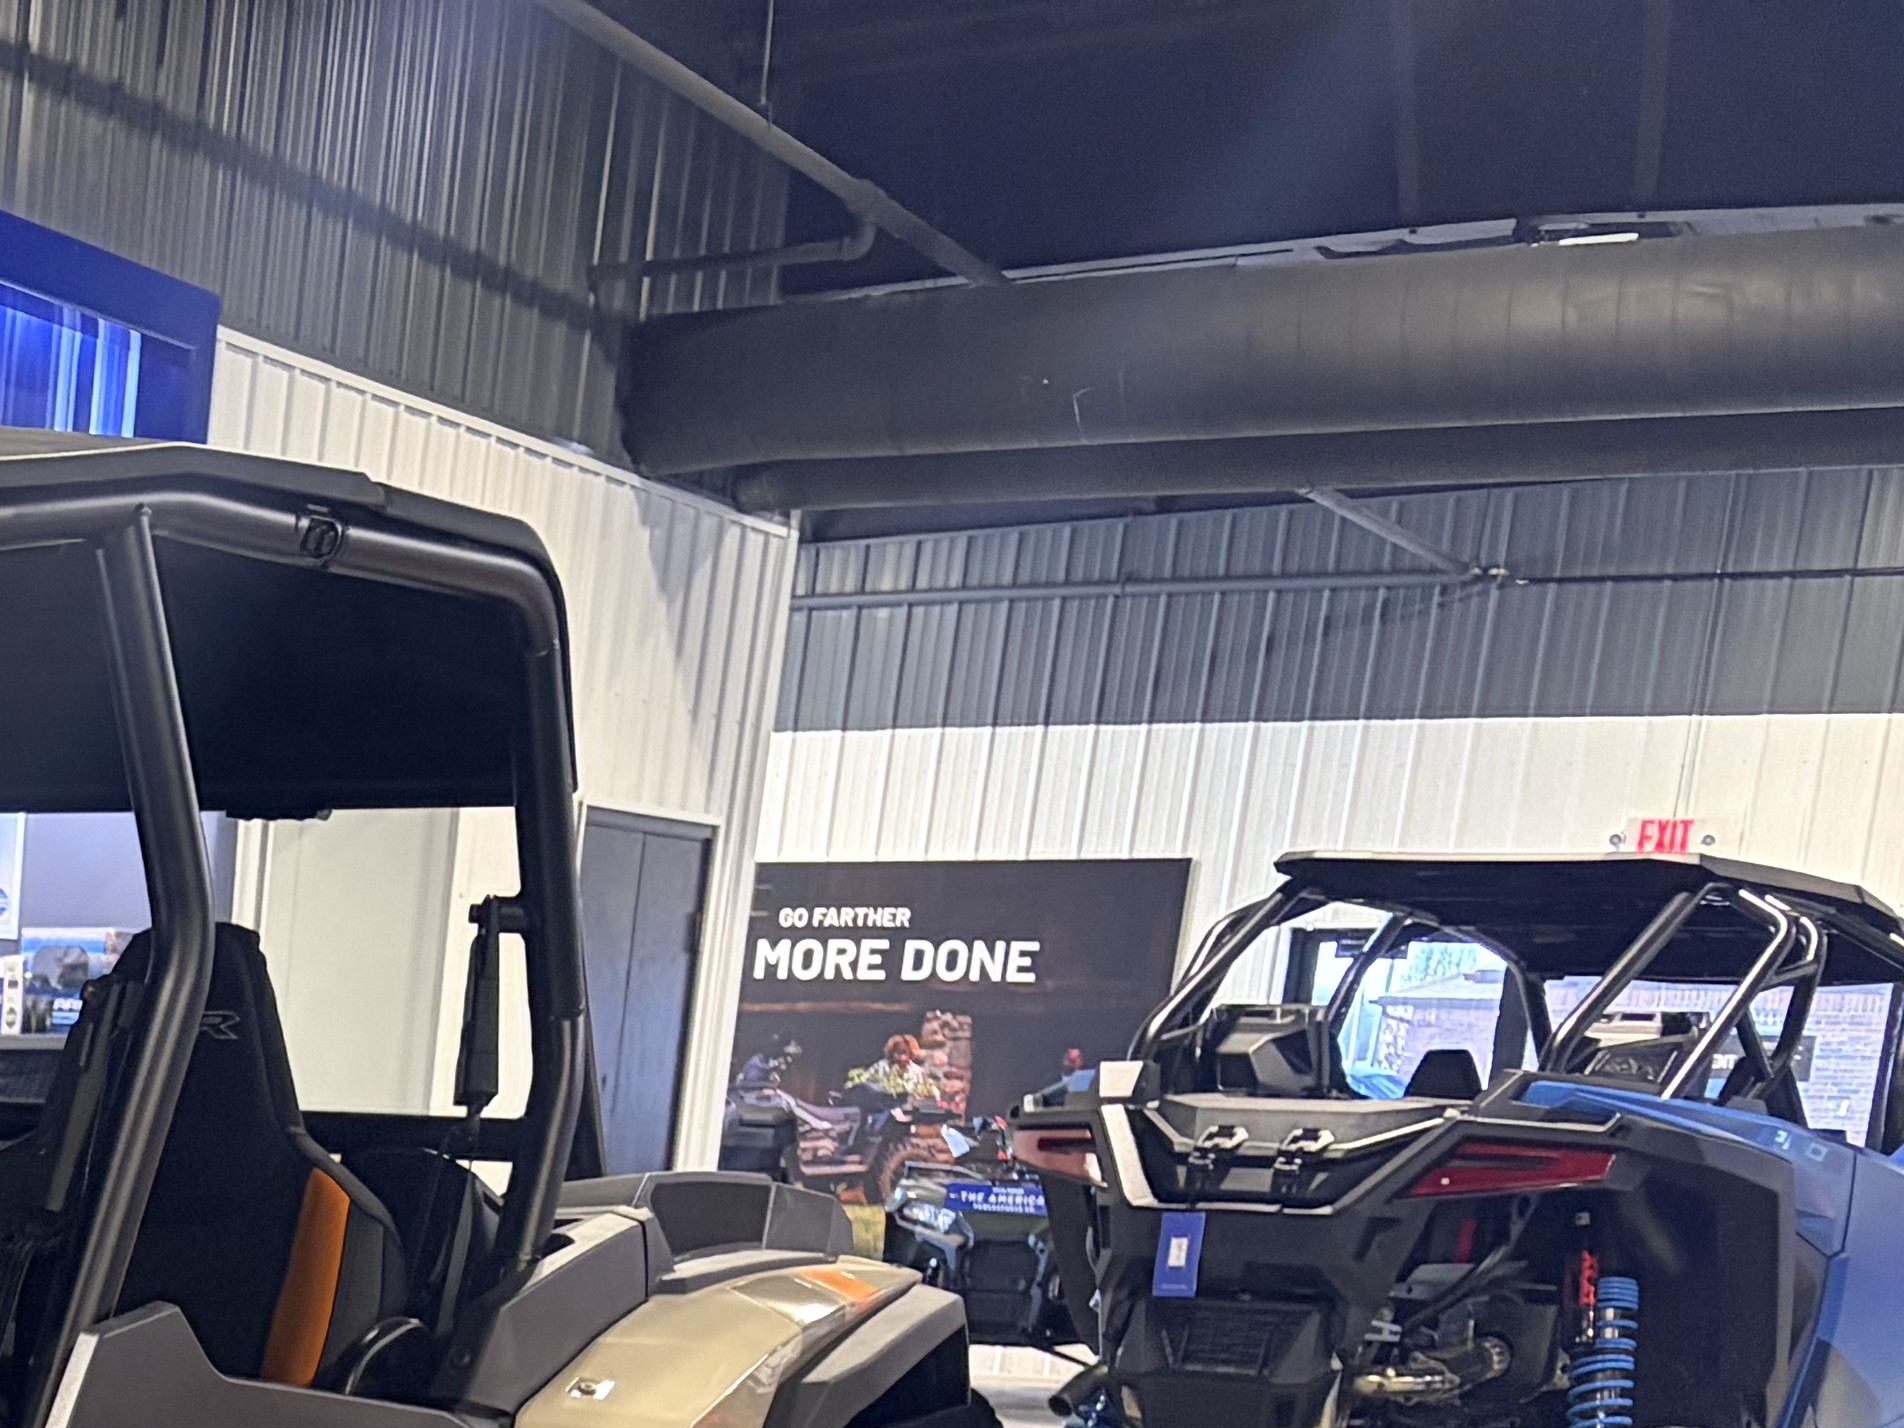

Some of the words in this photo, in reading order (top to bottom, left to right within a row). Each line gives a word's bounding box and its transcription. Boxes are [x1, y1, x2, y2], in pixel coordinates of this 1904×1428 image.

[1637, 819, 1695, 855] EXIT
[778, 907, 809, 928] GO
[812, 907, 912, 928] FARTHER
[753, 938, 890, 980] MORE
[901, 939, 1040, 983] DONE
